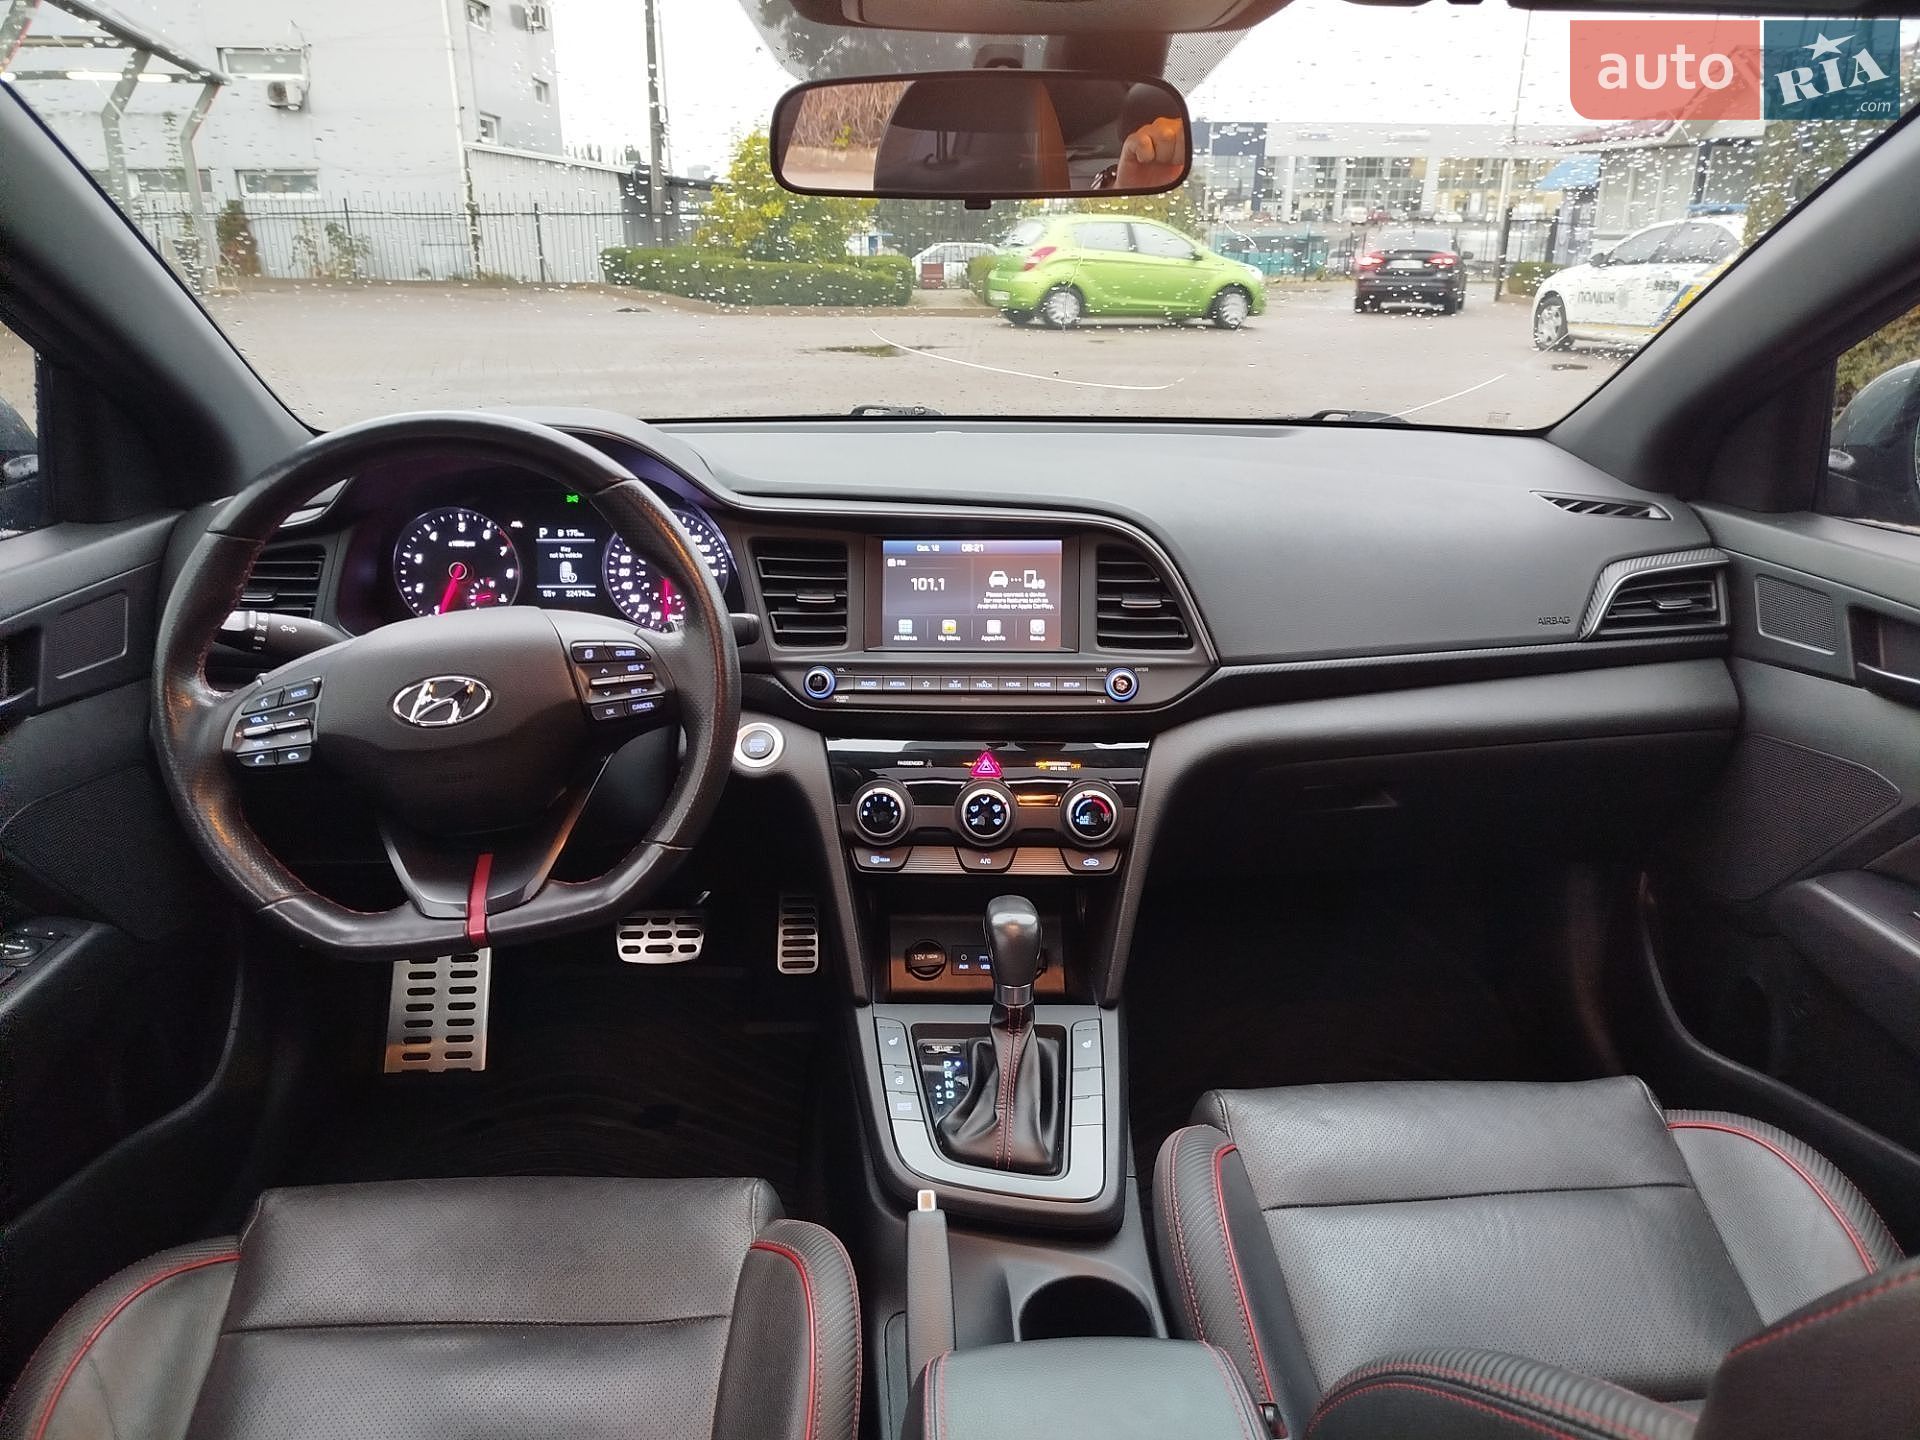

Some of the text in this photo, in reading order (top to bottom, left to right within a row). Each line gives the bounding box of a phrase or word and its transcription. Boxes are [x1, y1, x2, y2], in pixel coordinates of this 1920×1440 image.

[538, 527, 548, 538] P
[911, 577, 945, 591] 101.1
[1538, 616, 1571, 625] AIRBAG
[290, 689, 308, 698] MODE
[943, 1060, 952, 1069] P
[944, 1070, 953, 1079] R
[945, 1080, 954, 1089] N
[945, 1090, 955, 1099] D
